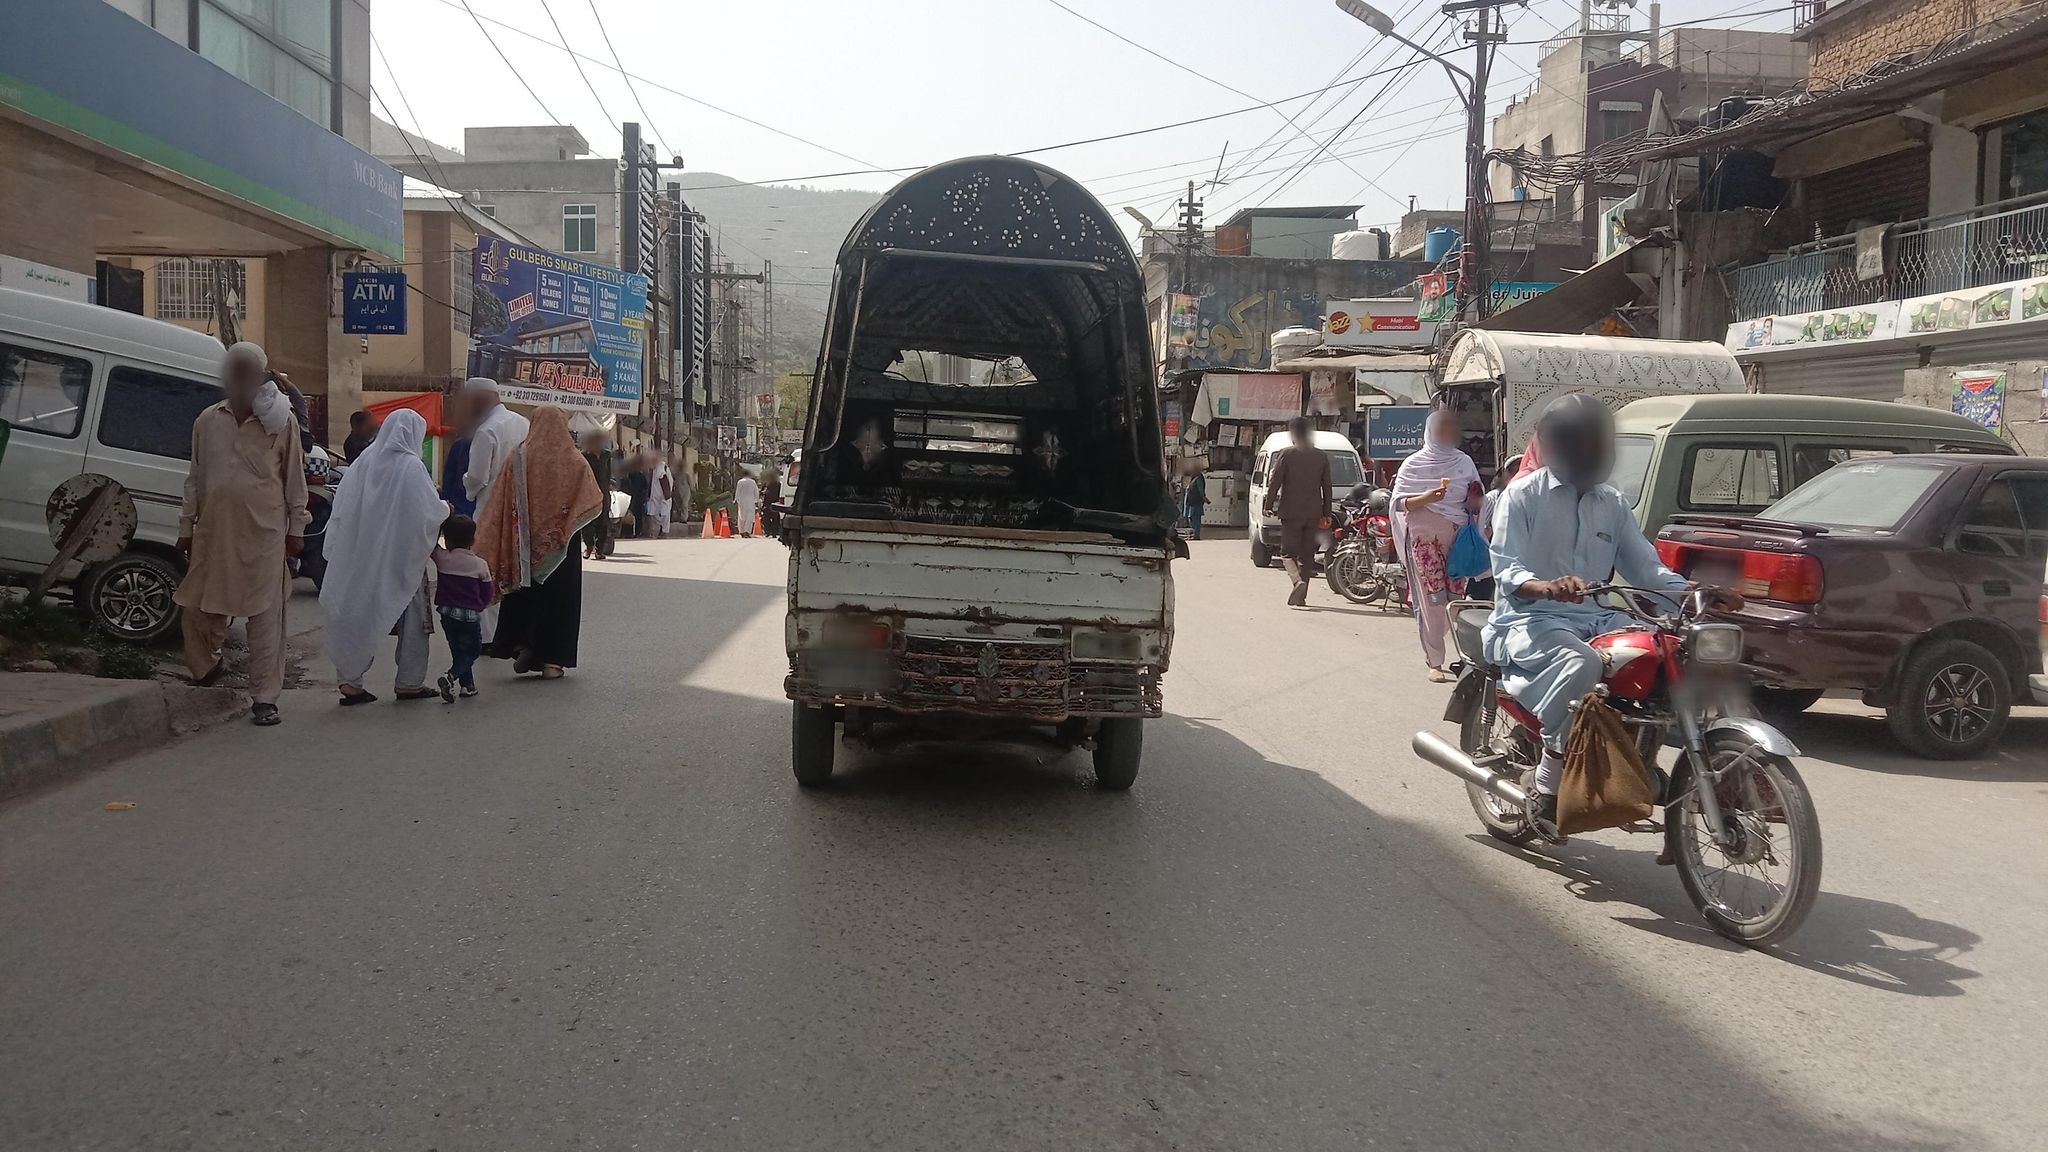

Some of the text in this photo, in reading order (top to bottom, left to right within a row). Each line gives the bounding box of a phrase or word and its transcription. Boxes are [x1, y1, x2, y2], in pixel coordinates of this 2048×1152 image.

[353, 160, 397, 200] MCB Bank
[509, 247, 625, 285] GULBERG SMART LIFESTYLE
[541, 273, 547, 287] 5
[352, 283, 395, 301] ATM
[541, 287, 561, 299] GULBERG
[573, 281, 579, 293] 7
[571, 294, 591, 305] GULBERG
[600, 287, 608, 300] 10
[508, 294, 533, 312] LIMITED
[542, 299, 559, 309] HOMES
[600, 300, 617, 311] GULBERG
[574, 304, 588, 315] VILLAS
[624, 309, 644, 321] 3 YEARS
[1375, 323, 1416, 331] Communication
[628, 328, 641, 346] 15%
[615, 360, 638, 371] 4 KANAL
[614, 371, 638, 383] 5 KANAL
[561, 374, 604, 394] BUILDERS
[612, 383, 638, 395] 10 KANAL
[1371, 437, 1390, 446] MAIN
[1391, 437, 1416, 446] BAZAR
